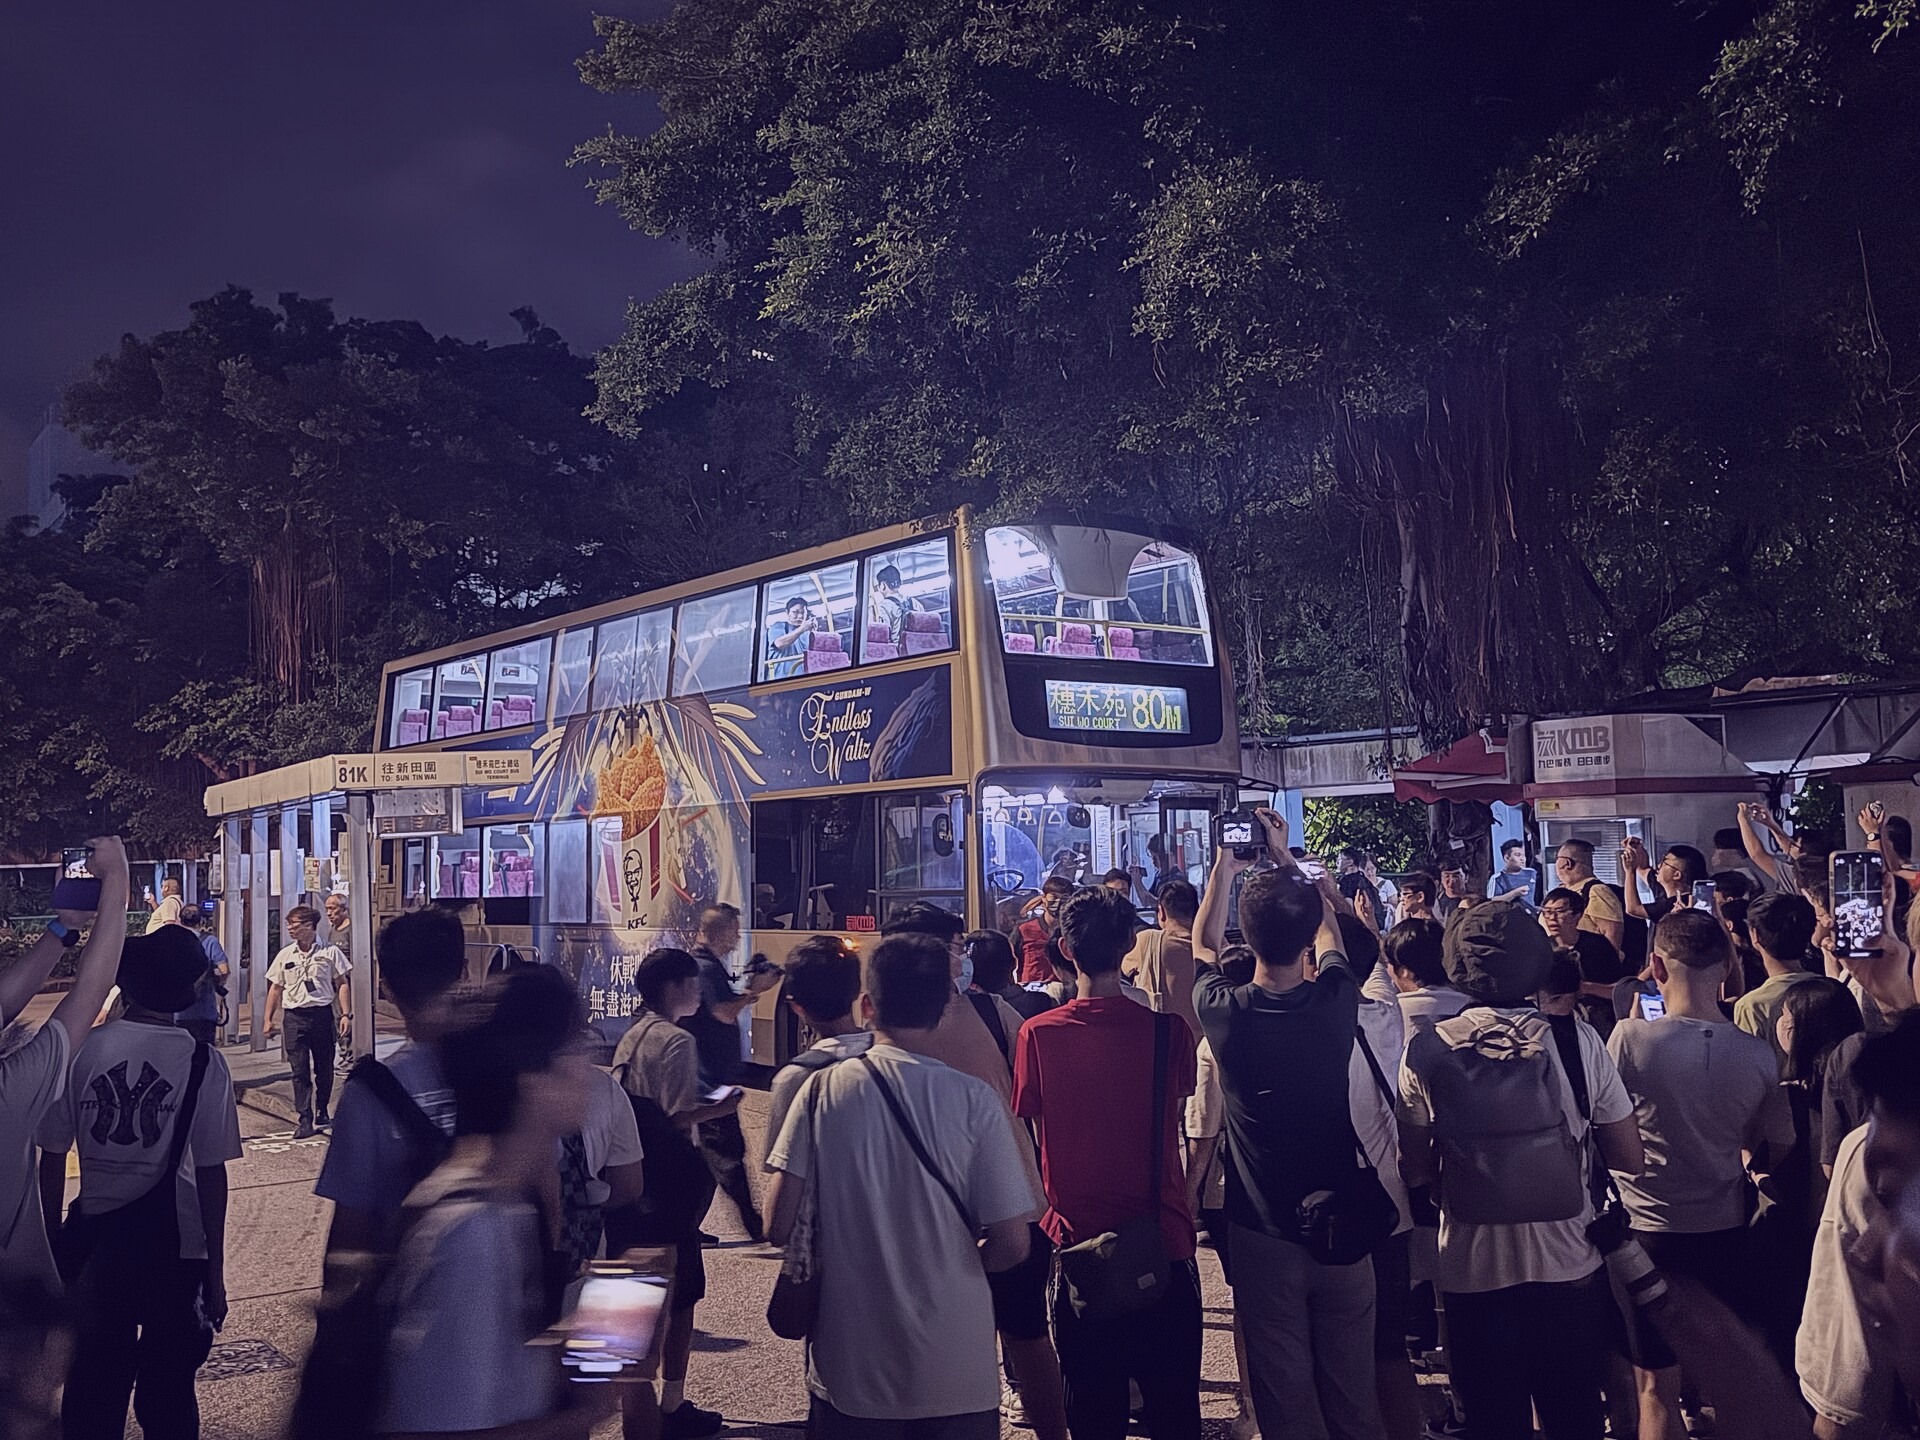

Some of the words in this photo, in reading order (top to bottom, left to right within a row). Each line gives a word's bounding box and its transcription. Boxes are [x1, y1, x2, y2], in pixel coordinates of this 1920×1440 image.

[1049, 683, 1127, 718] 穗禾苑
[1132, 688, 1182, 730] 80M
[799, 690, 873, 742] Endless
[1058, 715, 1075, 727] SUI
[1092, 717, 1121, 730] COURT
[1557, 726, 1610, 756] KMB
[811, 731, 871, 781] Waltz
[339, 766, 368, 783] 81K
[395, 774, 410, 782] SUN
[412, 773, 424, 781] TIN
[424, 773, 438, 781] WAI
[627, 913, 648, 930] KFC
[855, 915, 876, 931] KMB
